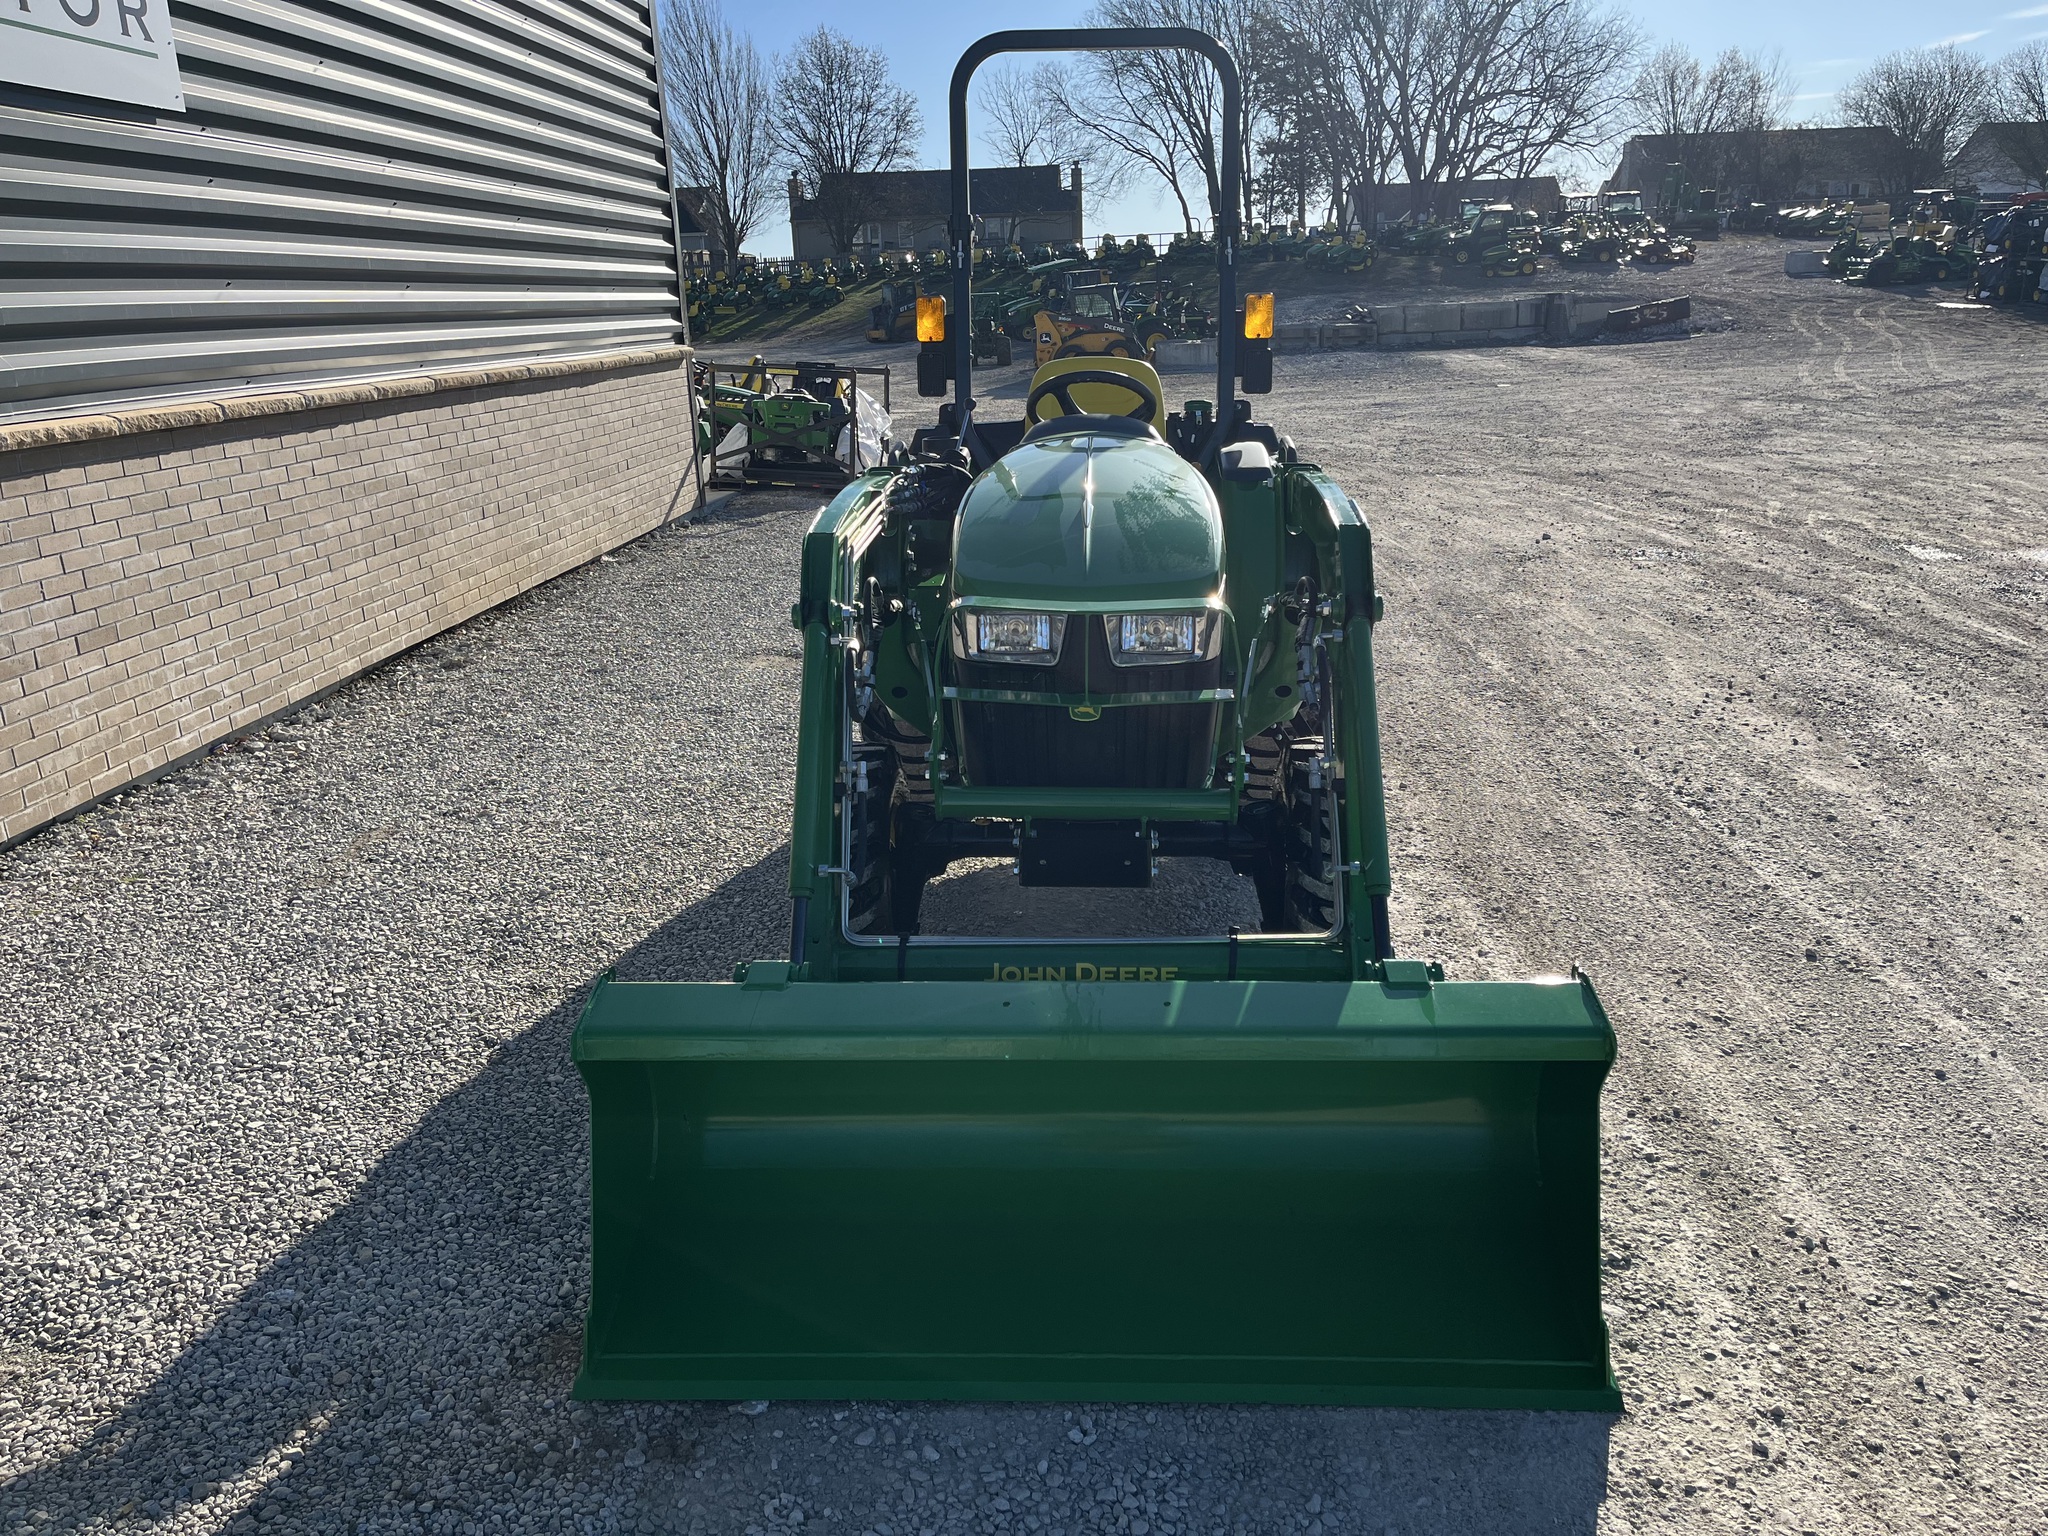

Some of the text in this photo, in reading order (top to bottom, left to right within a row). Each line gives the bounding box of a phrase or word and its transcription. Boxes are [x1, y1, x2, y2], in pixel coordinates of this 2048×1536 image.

[19, 0, 154, 43] OR
[1103, 322, 1125, 333] DEERE
[984, 962, 1179, 983] JOHN DEERE
